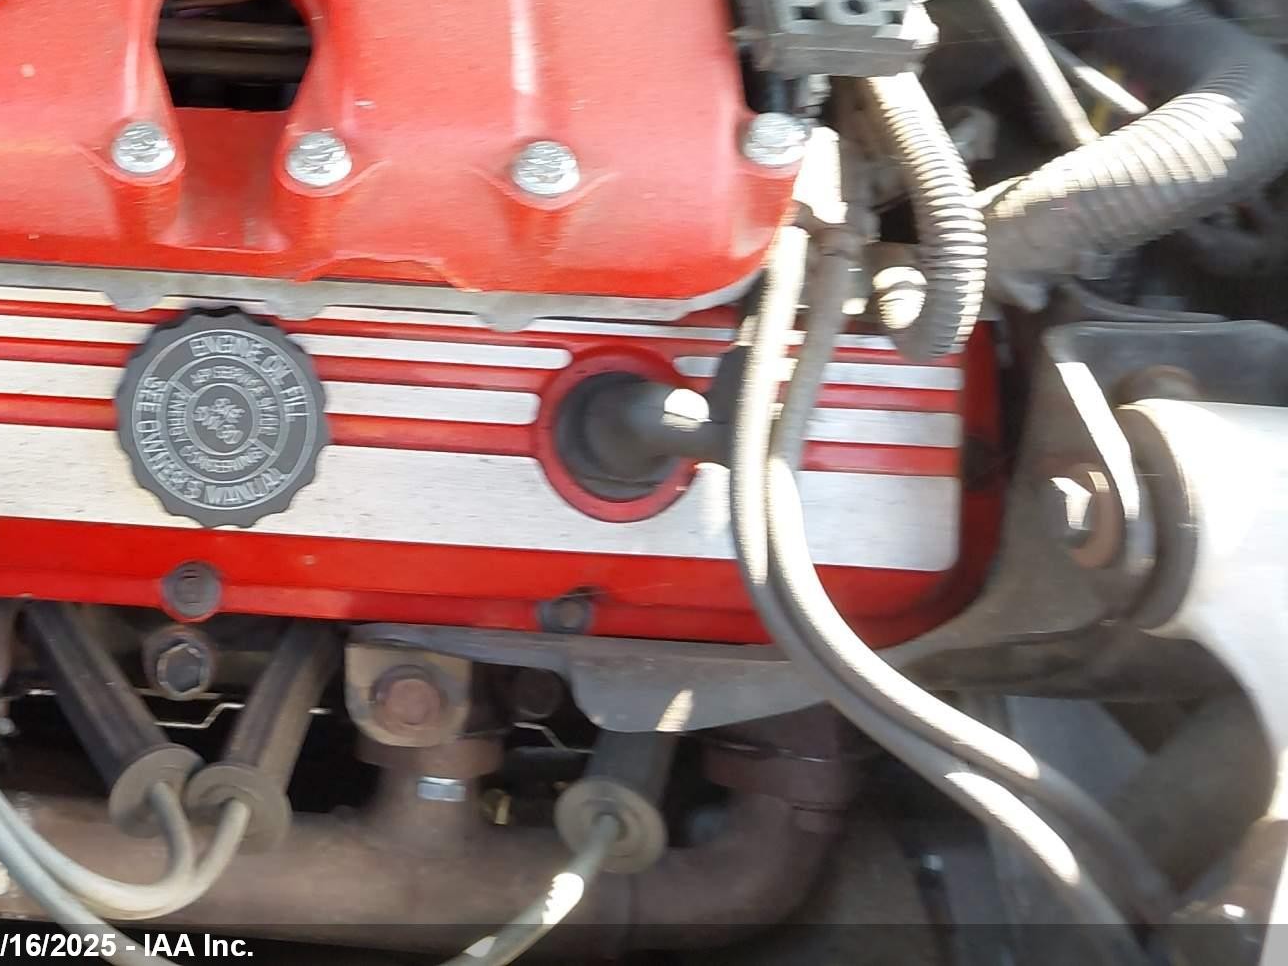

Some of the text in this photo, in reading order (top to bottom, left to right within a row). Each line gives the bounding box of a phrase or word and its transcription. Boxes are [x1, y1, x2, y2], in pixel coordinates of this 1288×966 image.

[189, 335, 310, 422] ENGINE OIL FILL
[136, 376, 167, 413] SEE
[203, 467, 292, 505] MANUAL
